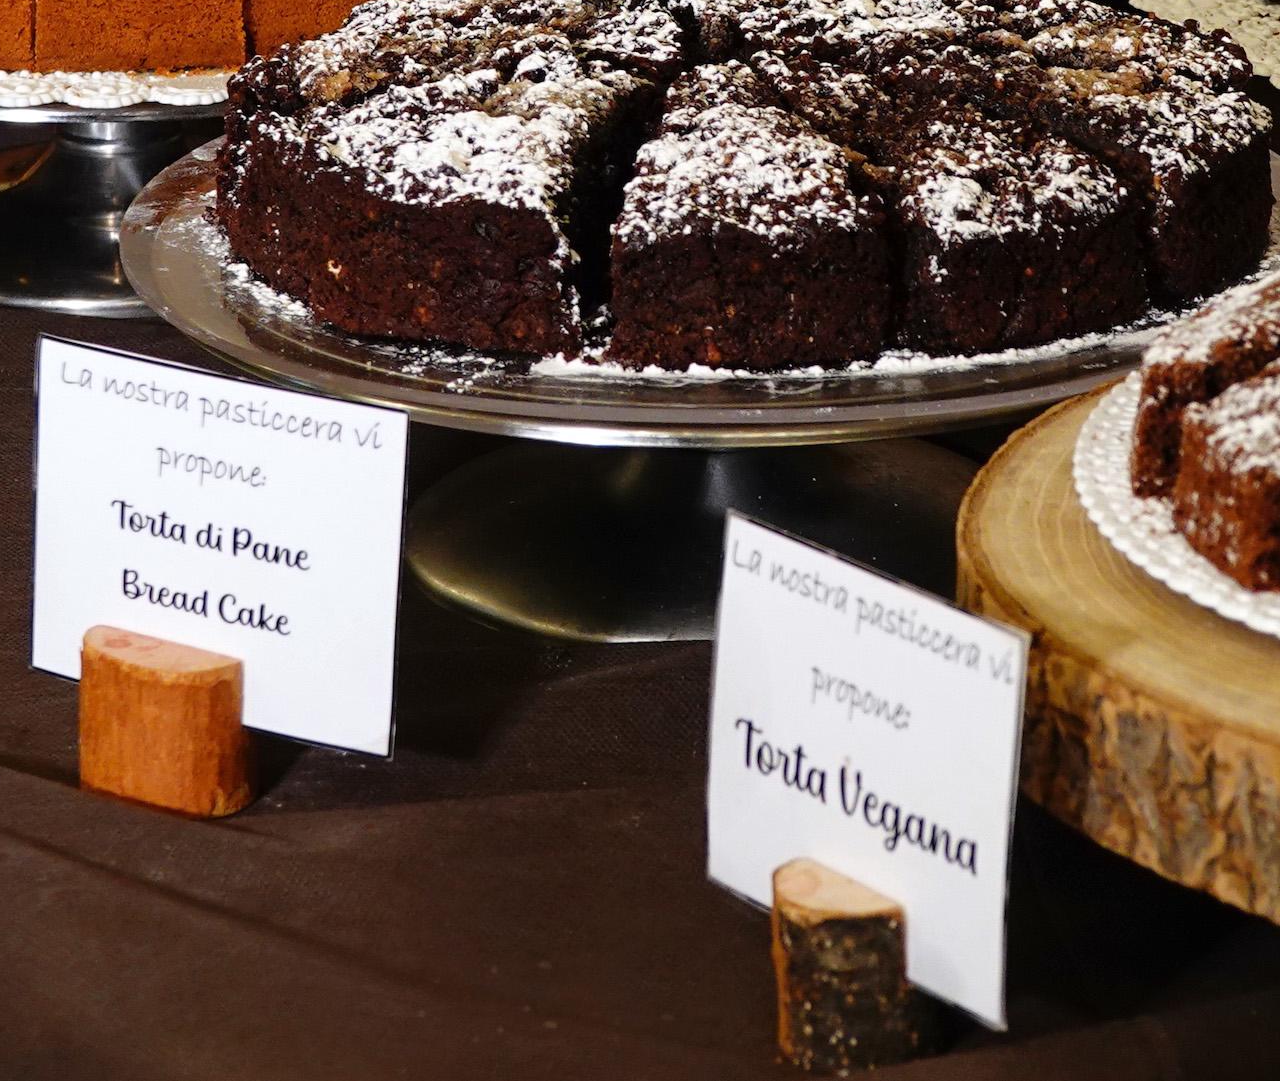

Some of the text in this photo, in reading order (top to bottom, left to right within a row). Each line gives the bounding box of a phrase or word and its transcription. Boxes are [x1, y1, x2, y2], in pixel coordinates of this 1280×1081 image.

[61, 361, 383, 450] La nostra pasticcera vi
[156, 446, 268, 487] propone:
[111, 499, 312, 571] Torta di Pane
[121, 568, 292, 637] Bread Cake
[731, 538, 1015, 686] La nostra pasticcera vi
[810, 665, 912, 731] propone:
[734, 718, 979, 876] Torta Vegana
